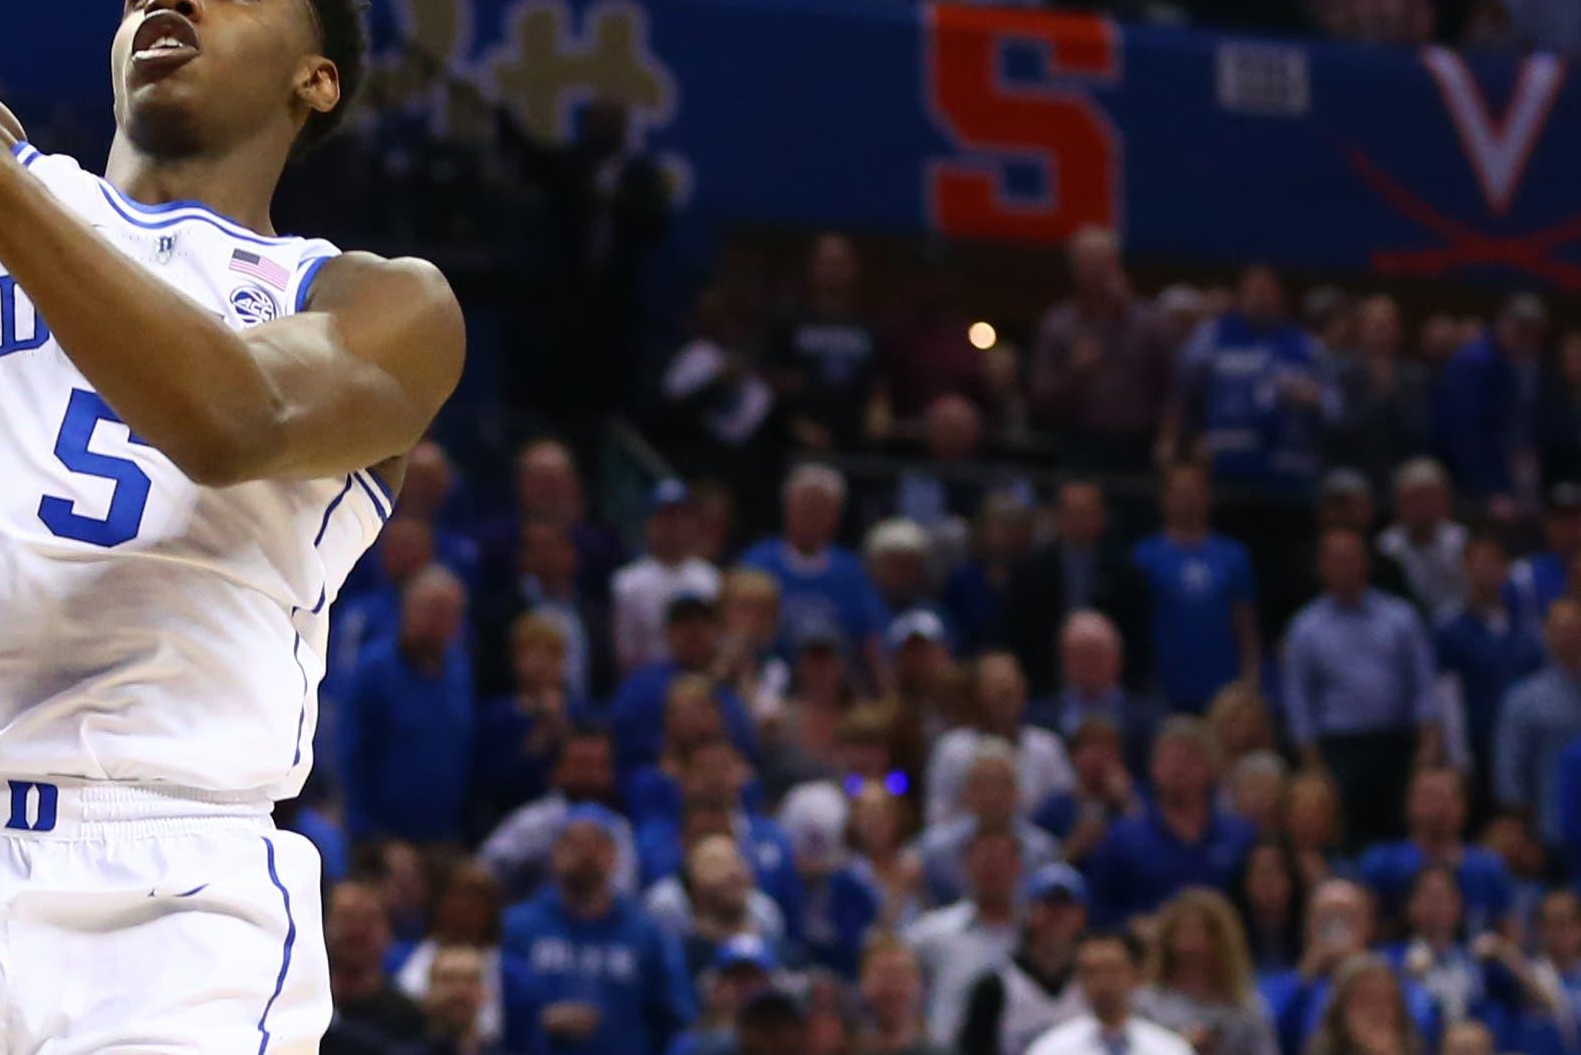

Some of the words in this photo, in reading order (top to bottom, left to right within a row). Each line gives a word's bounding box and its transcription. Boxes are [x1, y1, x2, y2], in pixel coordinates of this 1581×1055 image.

[1419, 43, 1569, 216] V
[37, 387, 153, 548] 5
[4, 780, 59, 832] D
